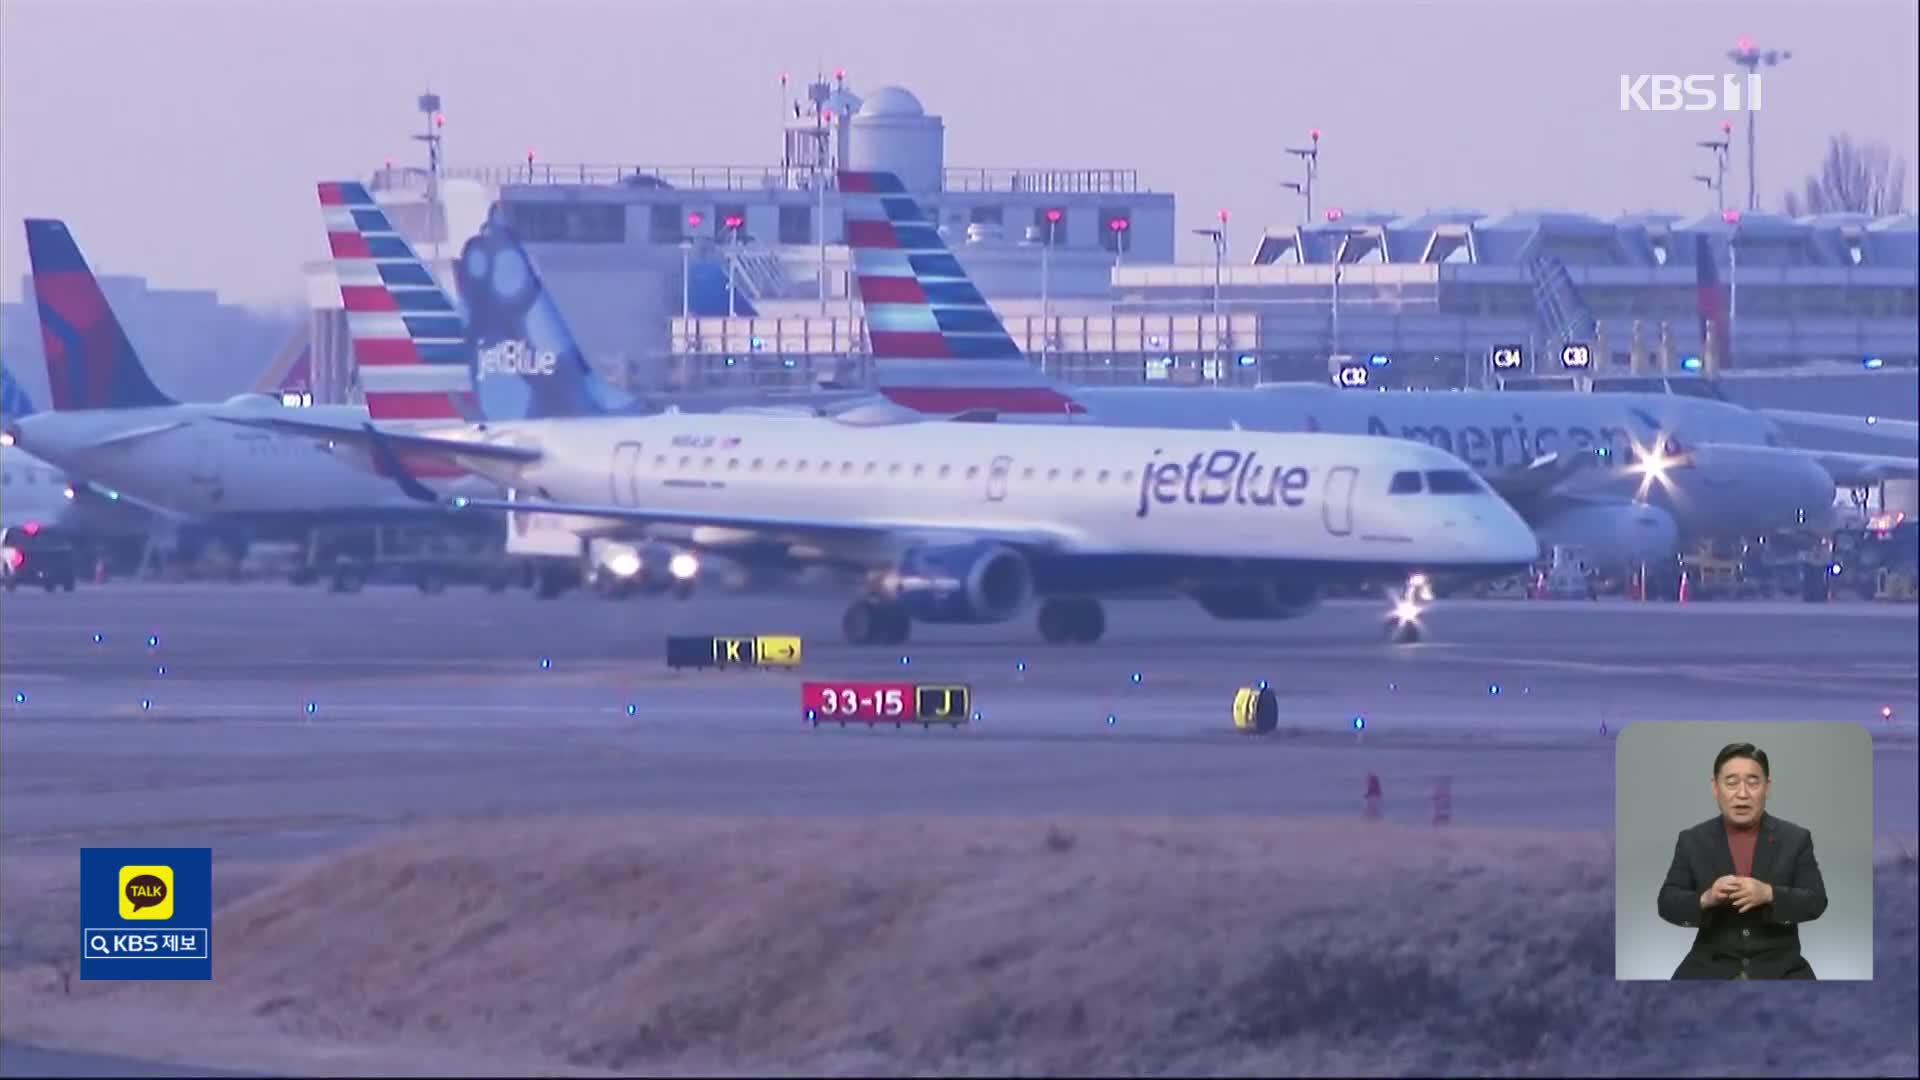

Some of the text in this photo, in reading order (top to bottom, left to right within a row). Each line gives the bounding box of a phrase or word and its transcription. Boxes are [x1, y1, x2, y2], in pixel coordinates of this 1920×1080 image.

[476, 337, 556, 382] jetBlue
[1136, 448, 1309, 518] jetBlue
[726, 640, 741, 662] K
[821, 688, 951, 716] 33-15 J
